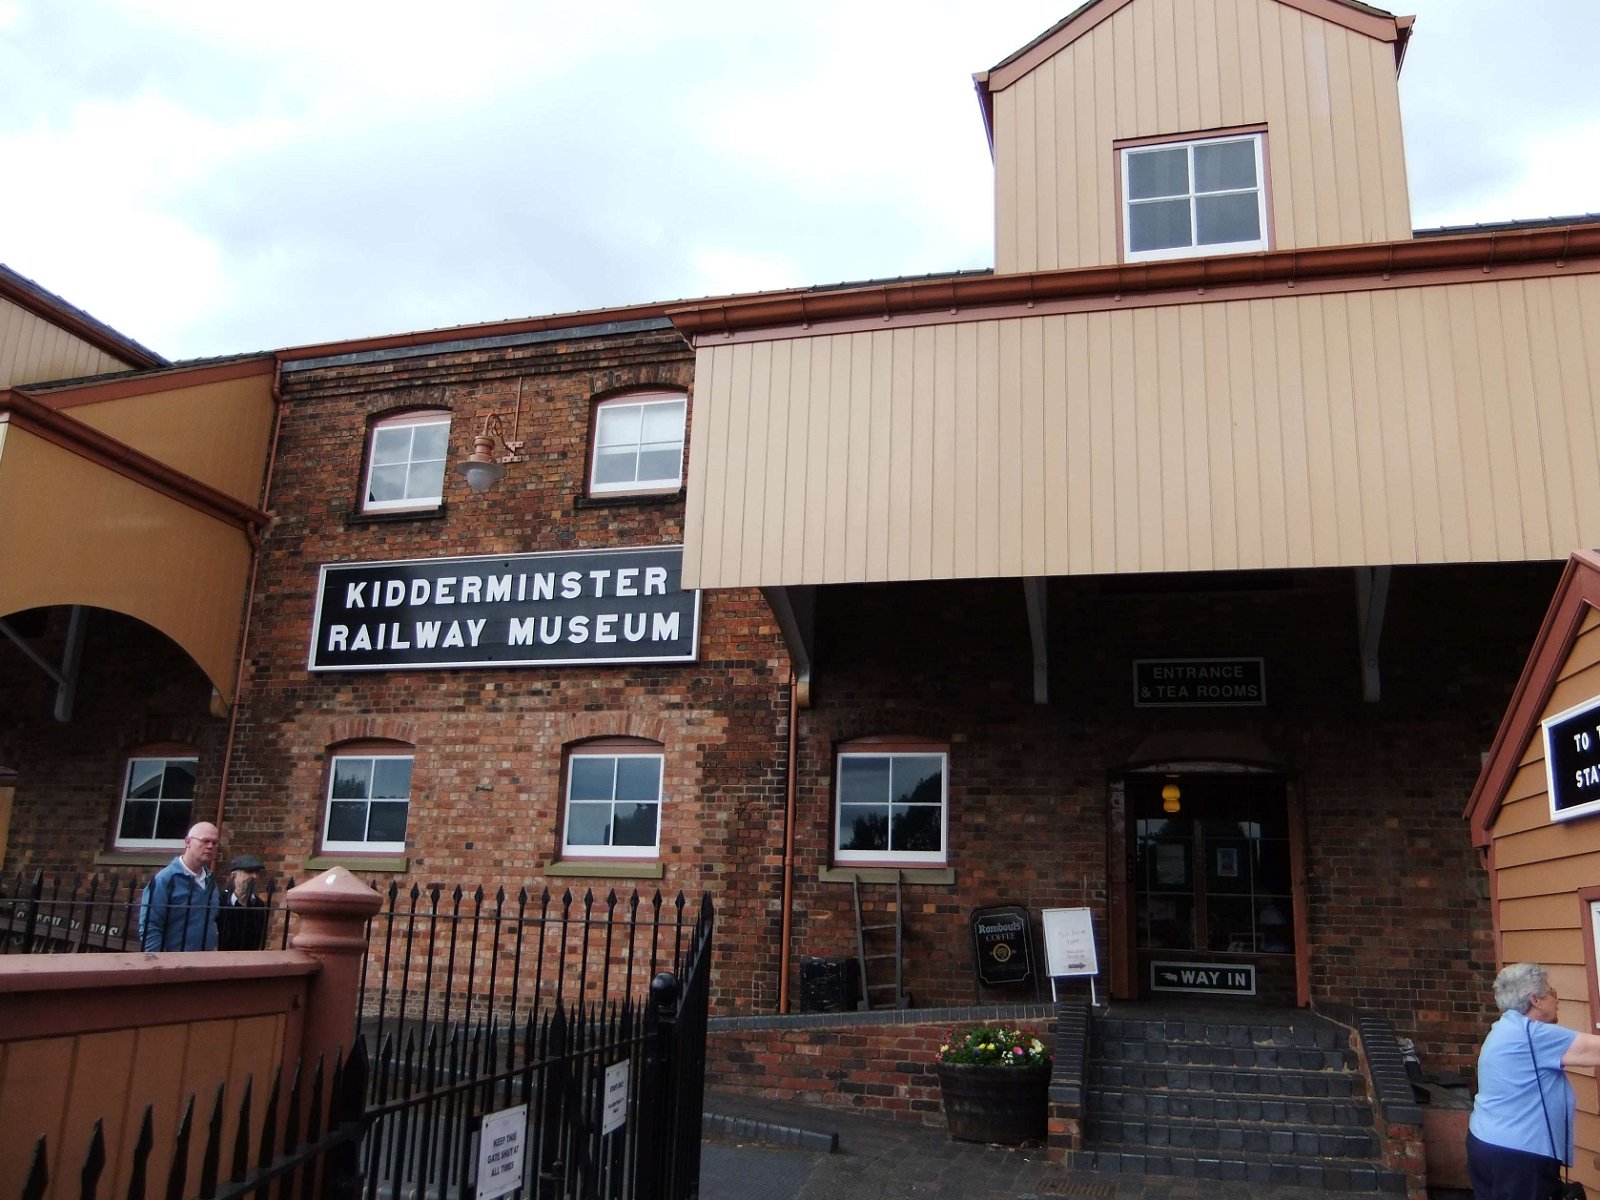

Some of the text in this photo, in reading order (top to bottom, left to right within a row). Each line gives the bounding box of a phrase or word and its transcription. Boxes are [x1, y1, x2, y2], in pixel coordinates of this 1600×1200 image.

[345, 566, 667, 609] KIDDERMINSTER
[328, 611, 680, 652] RAILWAY MUSEUM
[1153, 666, 1244, 680] ENTRANCE
[1140, 684, 1258, 698] & TEA ROOMS
[1573, 732, 1589, 752] TO
[977, 921, 1021, 934] Rombouts
[986, 932, 1016, 942] COFFEE
[1181, 970, 1246, 986] WAY IN
[493, 1132, 518, 1148] KEEP THIS
[487, 1145, 519, 1164] GATE SHUT AT
[490, 1161, 514, 1178] ALL TIMES
